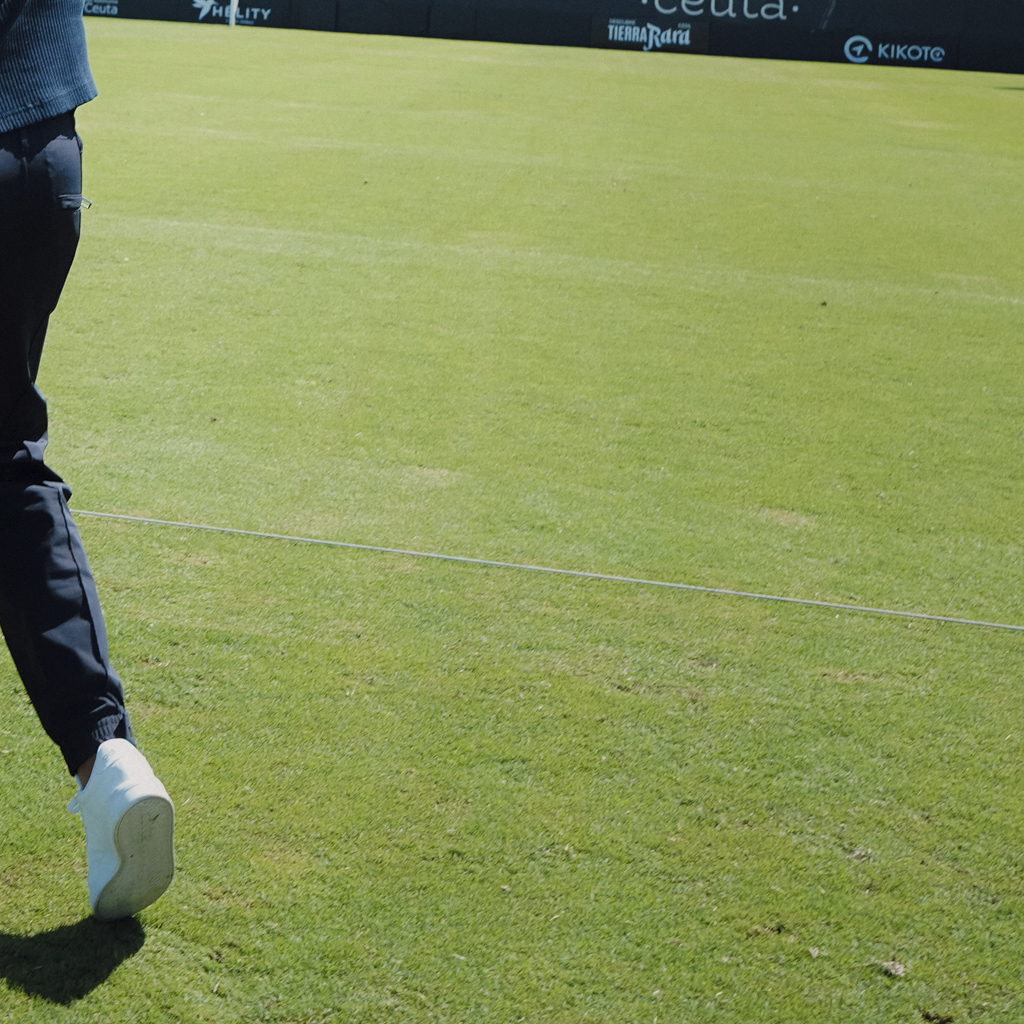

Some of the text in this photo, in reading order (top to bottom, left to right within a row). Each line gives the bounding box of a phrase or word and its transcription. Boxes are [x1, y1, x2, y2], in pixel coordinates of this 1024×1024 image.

[84, 2, 119, 15] Ceuta
[608, 22, 691, 52] TIERRA Rara
